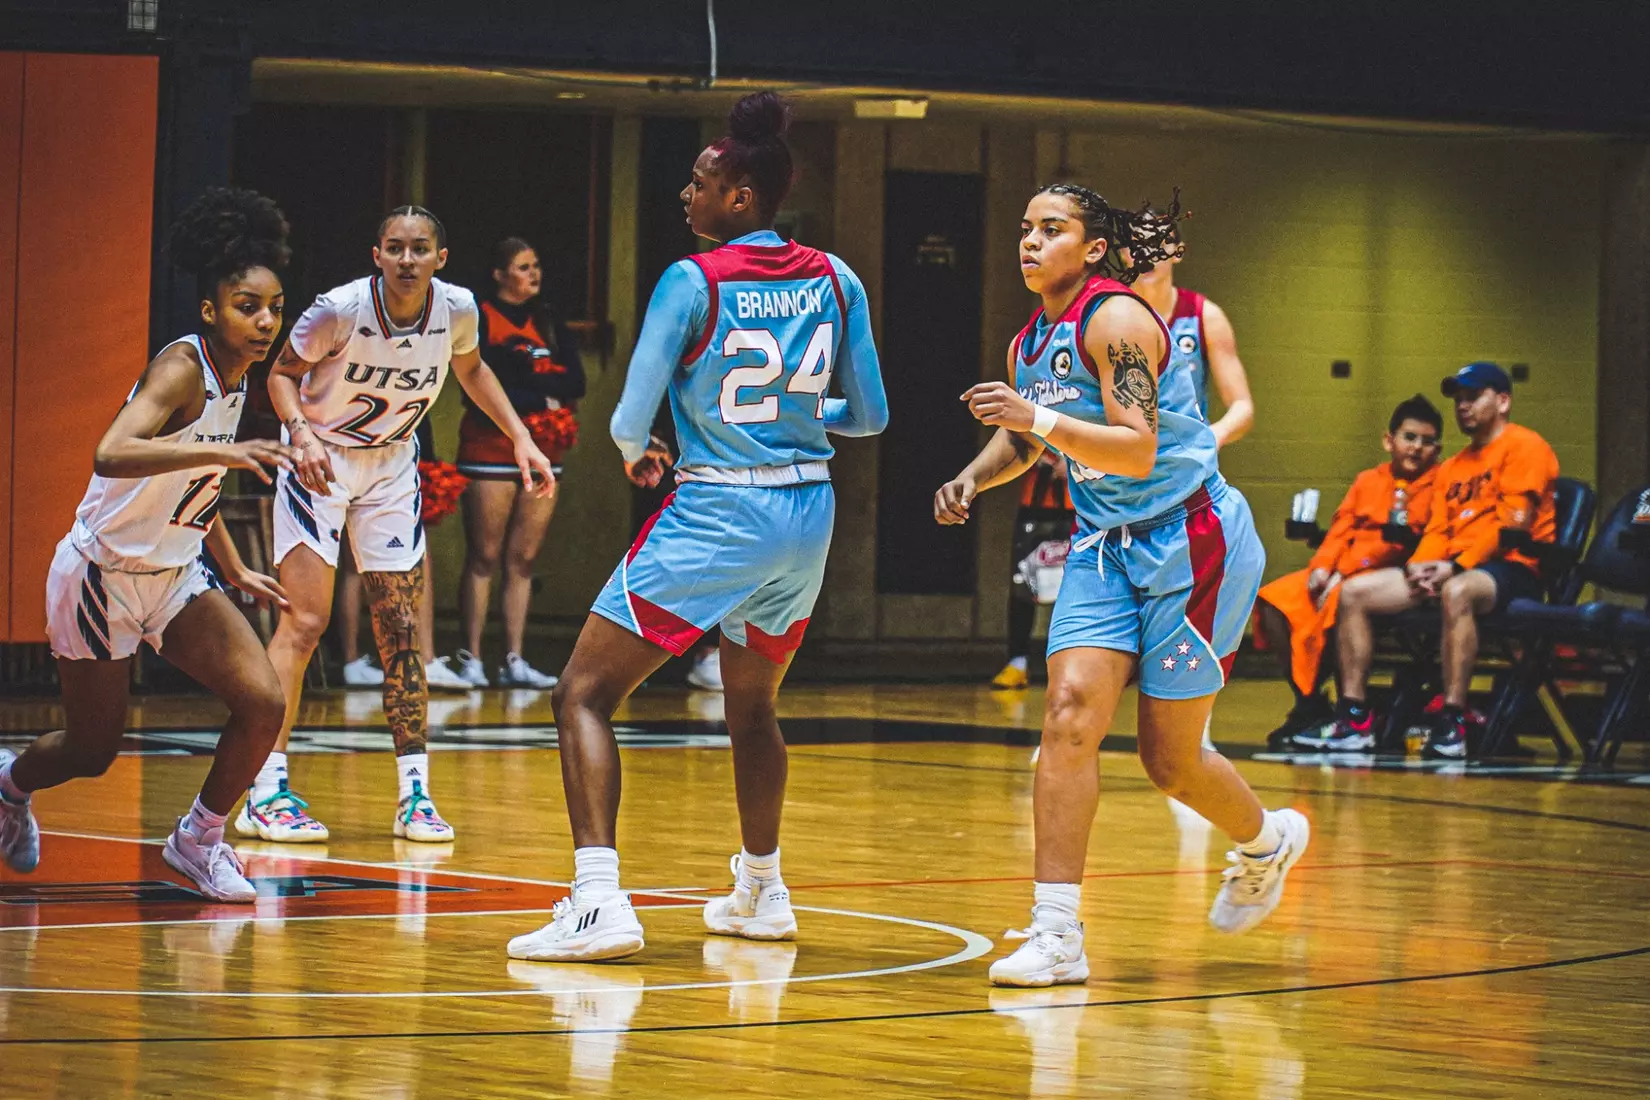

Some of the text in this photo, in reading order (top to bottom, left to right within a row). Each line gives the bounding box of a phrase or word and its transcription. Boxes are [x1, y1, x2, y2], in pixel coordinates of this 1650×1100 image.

[735, 287, 823, 319] BRANNON
[344, 362, 438, 391] UTSA
[718, 321, 834, 425] 24
[329, 393, 430, 445] 22
